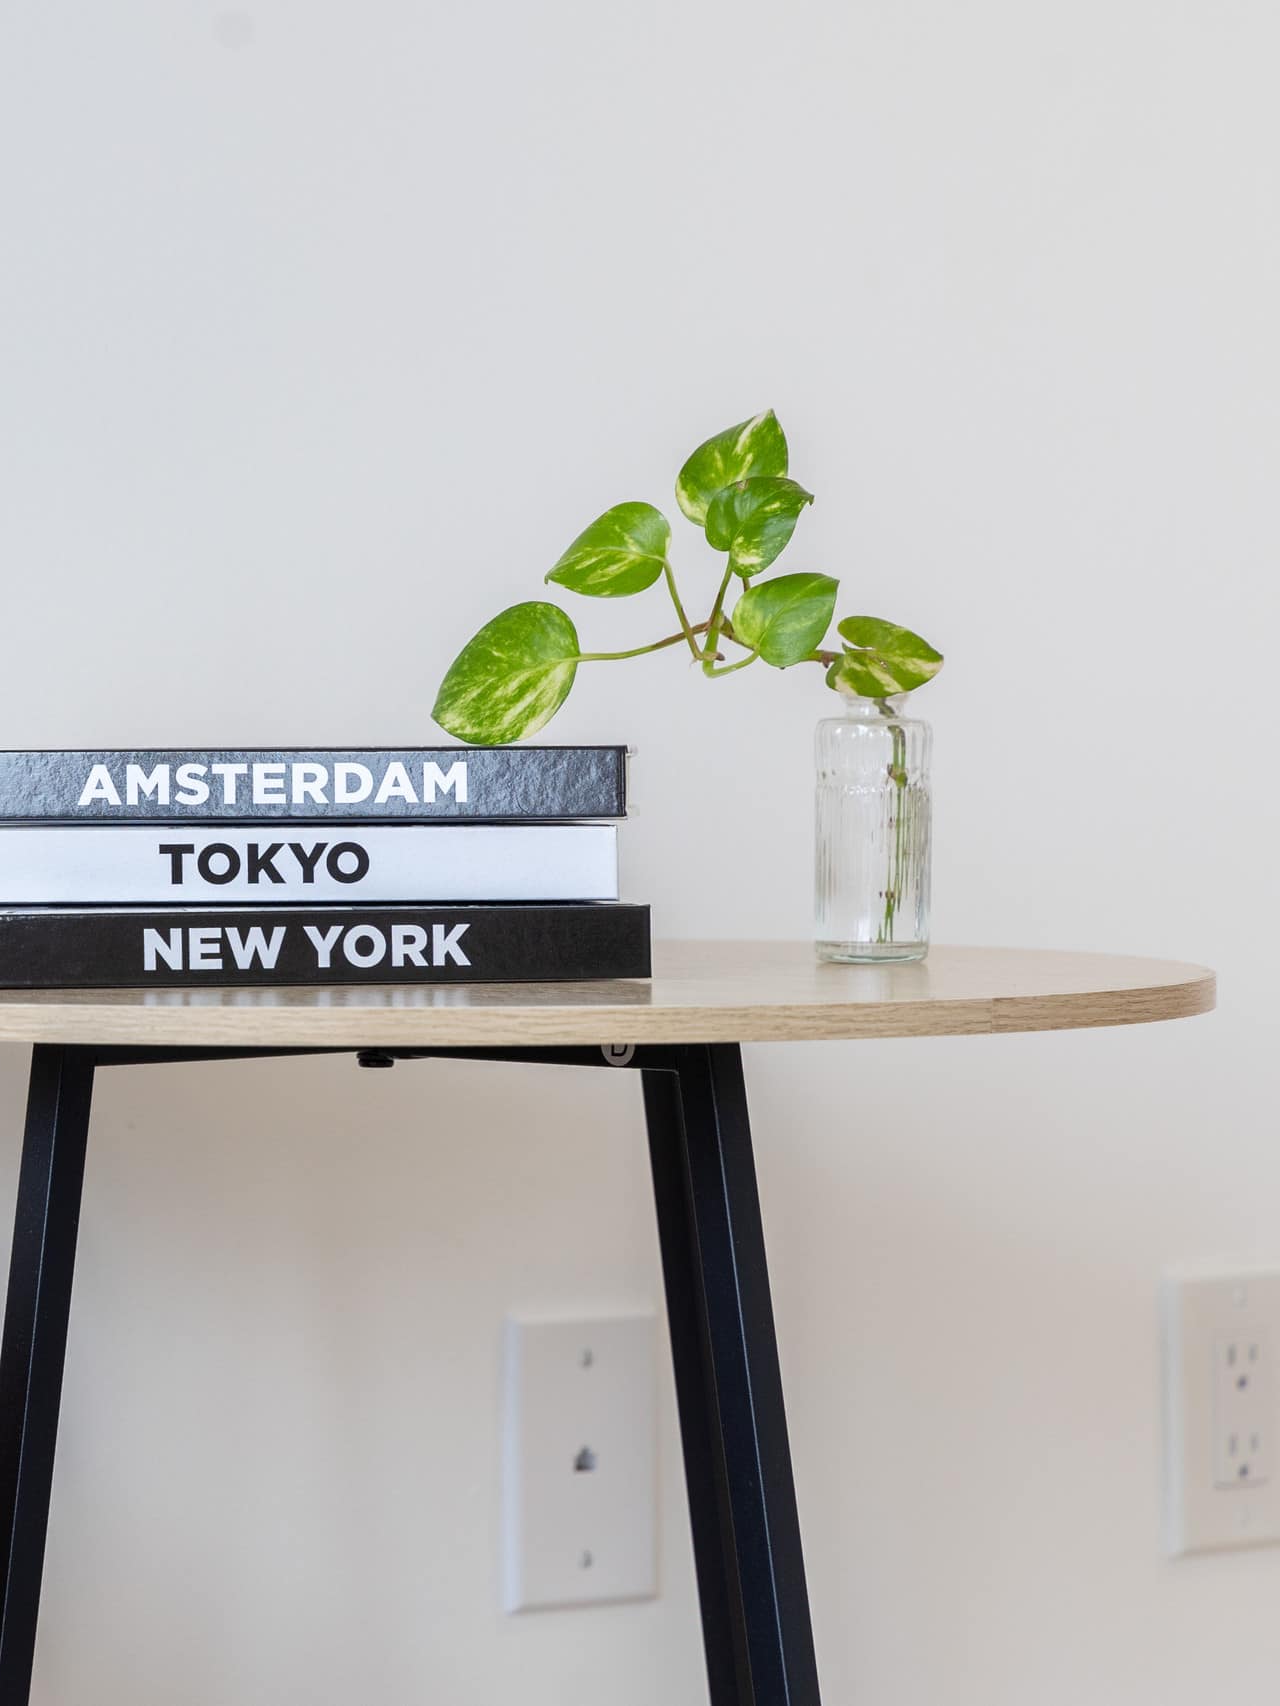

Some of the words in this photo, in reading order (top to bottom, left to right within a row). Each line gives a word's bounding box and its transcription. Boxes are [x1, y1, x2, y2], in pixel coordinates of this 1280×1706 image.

[76, 760, 470, 807] AMSTERDAM
[158, 841, 371, 885] TOKYO
[143, 925, 286, 971] NEW
[302, 923, 471, 968] YORK
